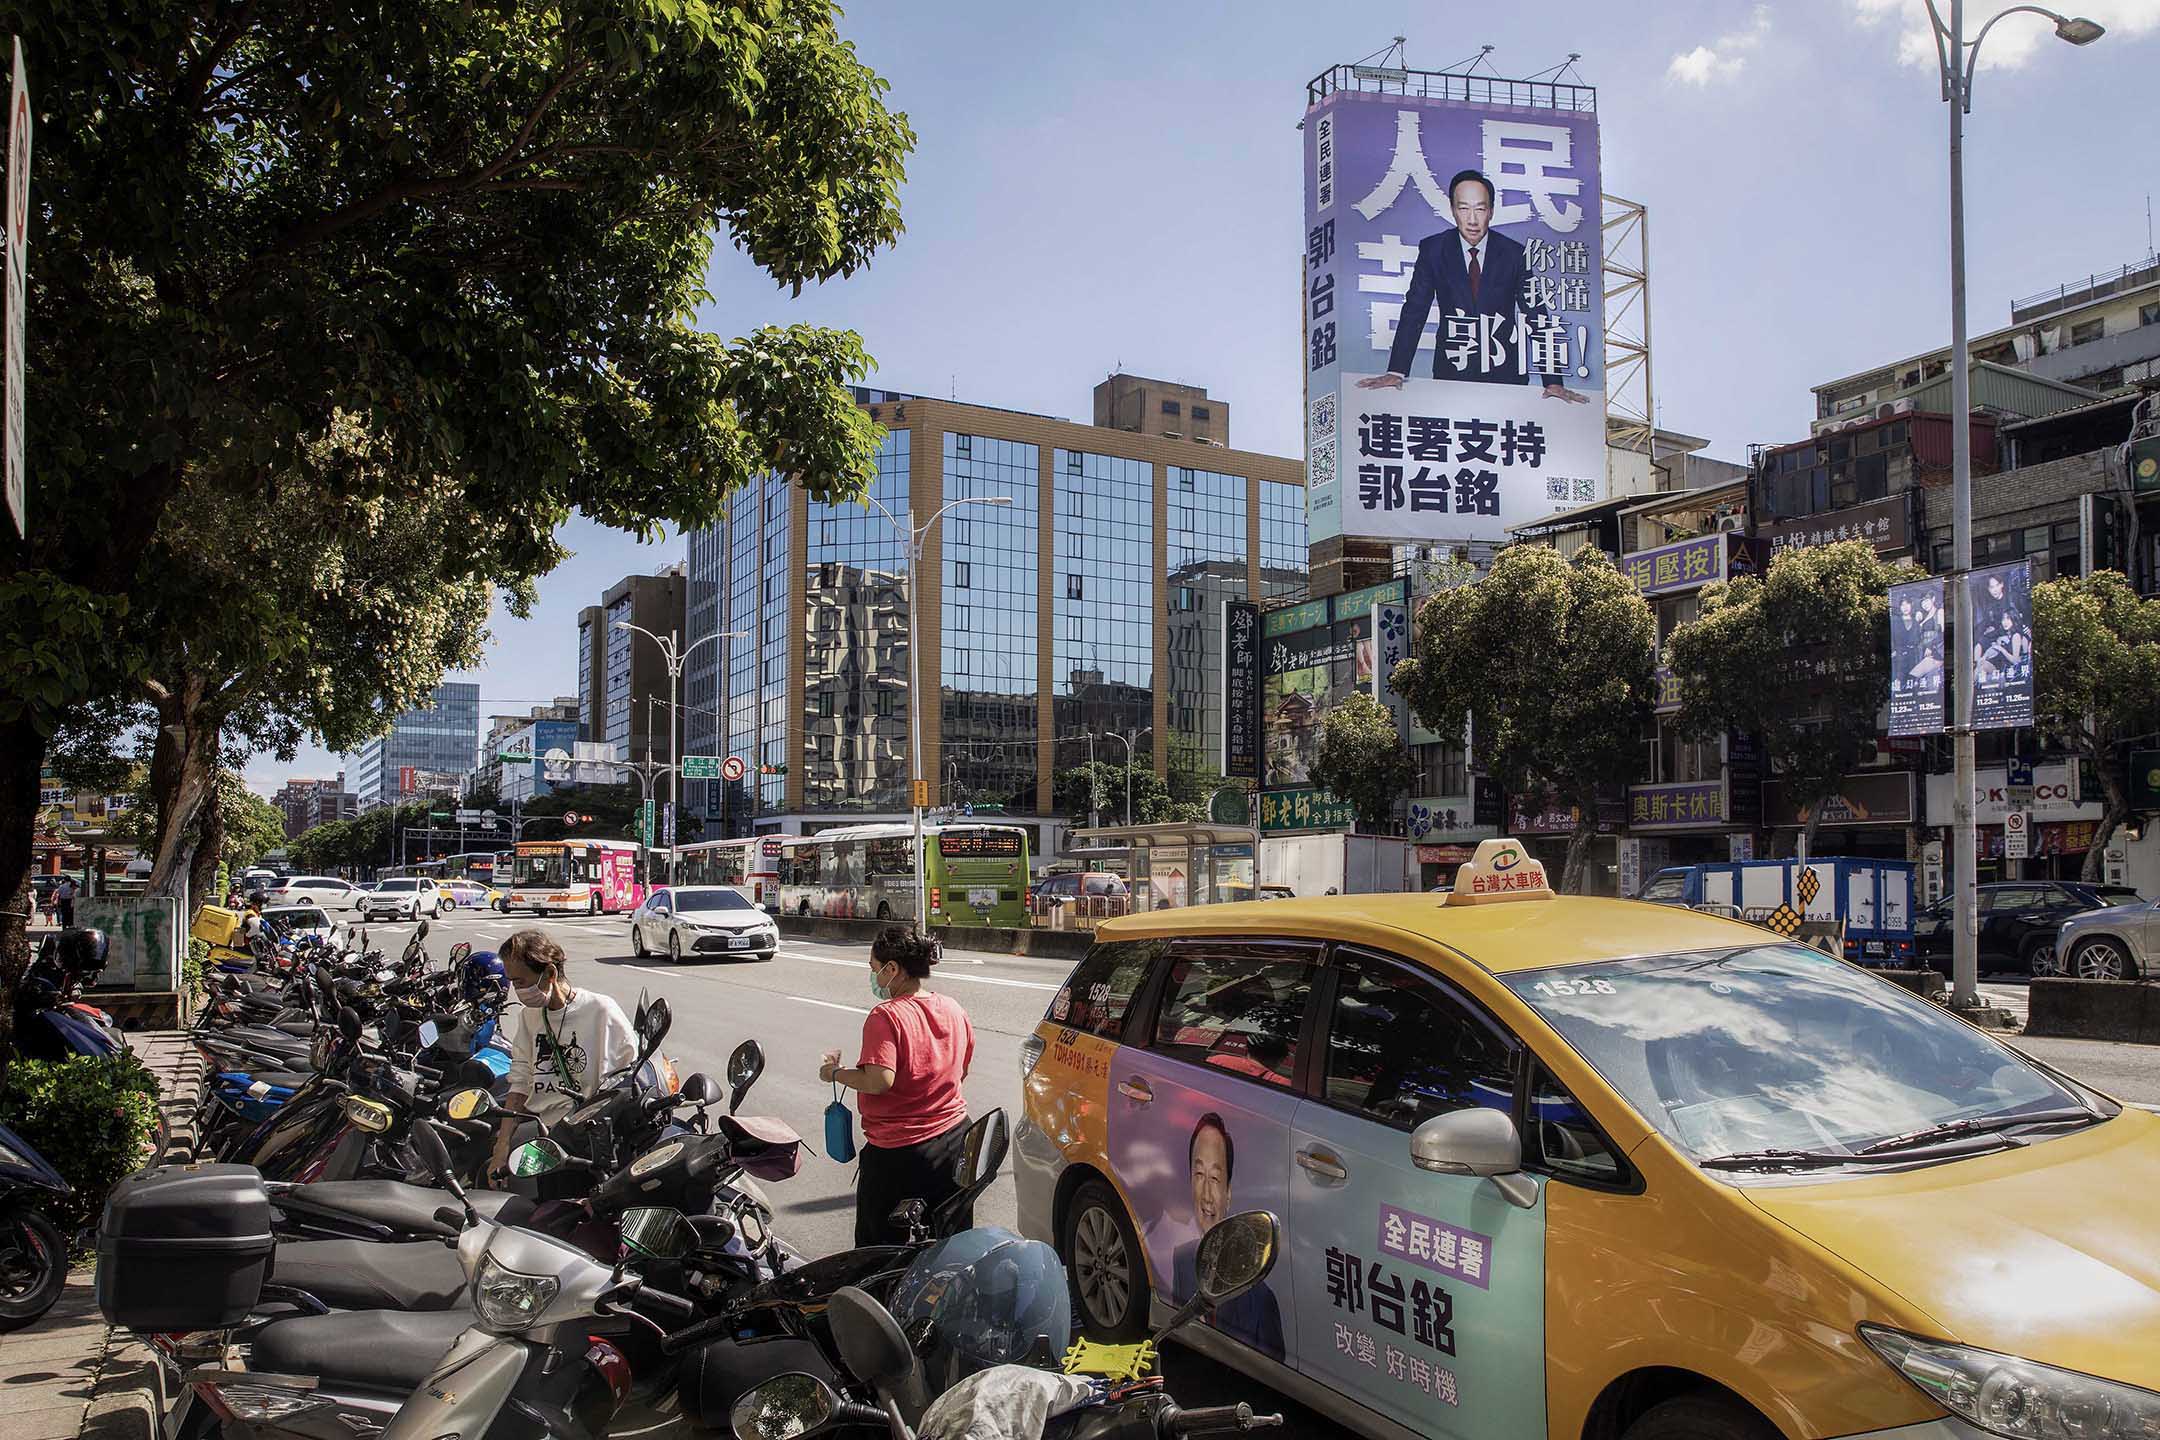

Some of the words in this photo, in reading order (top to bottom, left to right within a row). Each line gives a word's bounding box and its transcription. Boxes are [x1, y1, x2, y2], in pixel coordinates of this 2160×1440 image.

[1318, 119, 1332, 206] 全民連署
[1350, 109, 1586, 233] 人民
[1522, 237, 1591, 275] 你懂
[1308, 217, 1337, 372] 郭台銘
[1522, 275, 1591, 312] 我懂
[1358, 412, 1547, 469] 連署支持
[1357, 463, 1501, 517] 郭台銘
[1628, 544, 1720, 588] 指壓按
[1231, 608, 1253, 669] 鄧老師
[1270, 640, 1309, 672] 鄧老師
[2008, 758, 2020, 777] P
[1262, 792, 1310, 827] 鄧老師
[1988, 783, 2068, 803] KCO
[1472, 871, 1545, 893] 台灣大車隊
[1088, 982, 1112, 1001] 1528
[1533, 980, 1617, 998] 1528
[1056, 1028, 1081, 1047] 1528
[533, 1081, 582, 1094] PAS
[1384, 1213, 1484, 1279] 全民連署
[1325, 1246, 1457, 1358] 郭台銘
[1333, 1322, 1378, 1368] 改變
[1384, 1344, 1460, 1407] 好時機
